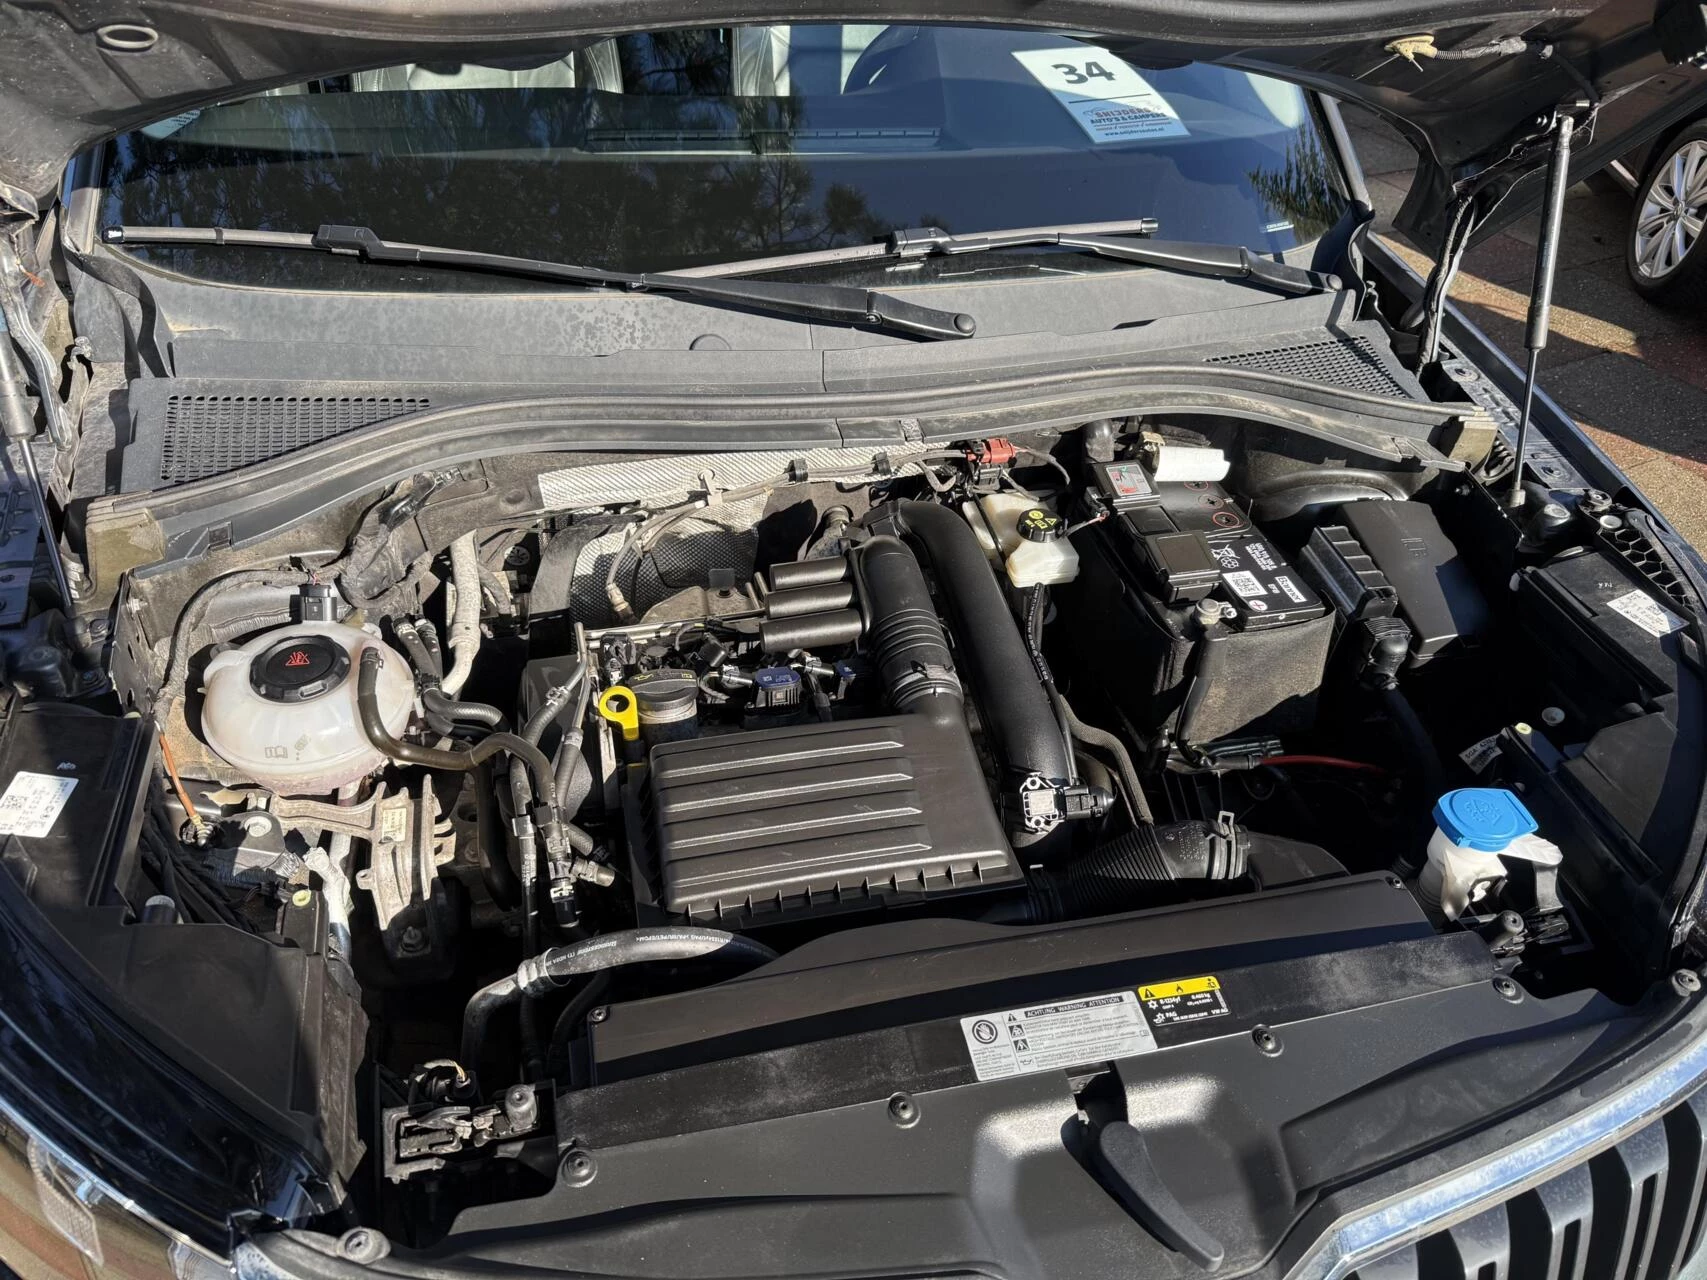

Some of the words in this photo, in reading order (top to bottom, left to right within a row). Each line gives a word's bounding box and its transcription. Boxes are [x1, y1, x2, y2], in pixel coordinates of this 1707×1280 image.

[1051, 61, 1116, 84] 34
[1090, 116, 1120, 124] AUTO'S
[1128, 112, 1167, 121] CAMPERS
[1095, 107, 1152, 118] SNIJDERS
[1278, 576, 1303, 601] Banner
[1027, 1008, 1056, 1017] ACHTUNG
[1058, 1001, 1087, 1012] WARNING
[1089, 996, 1120, 1007] ATTENTION
